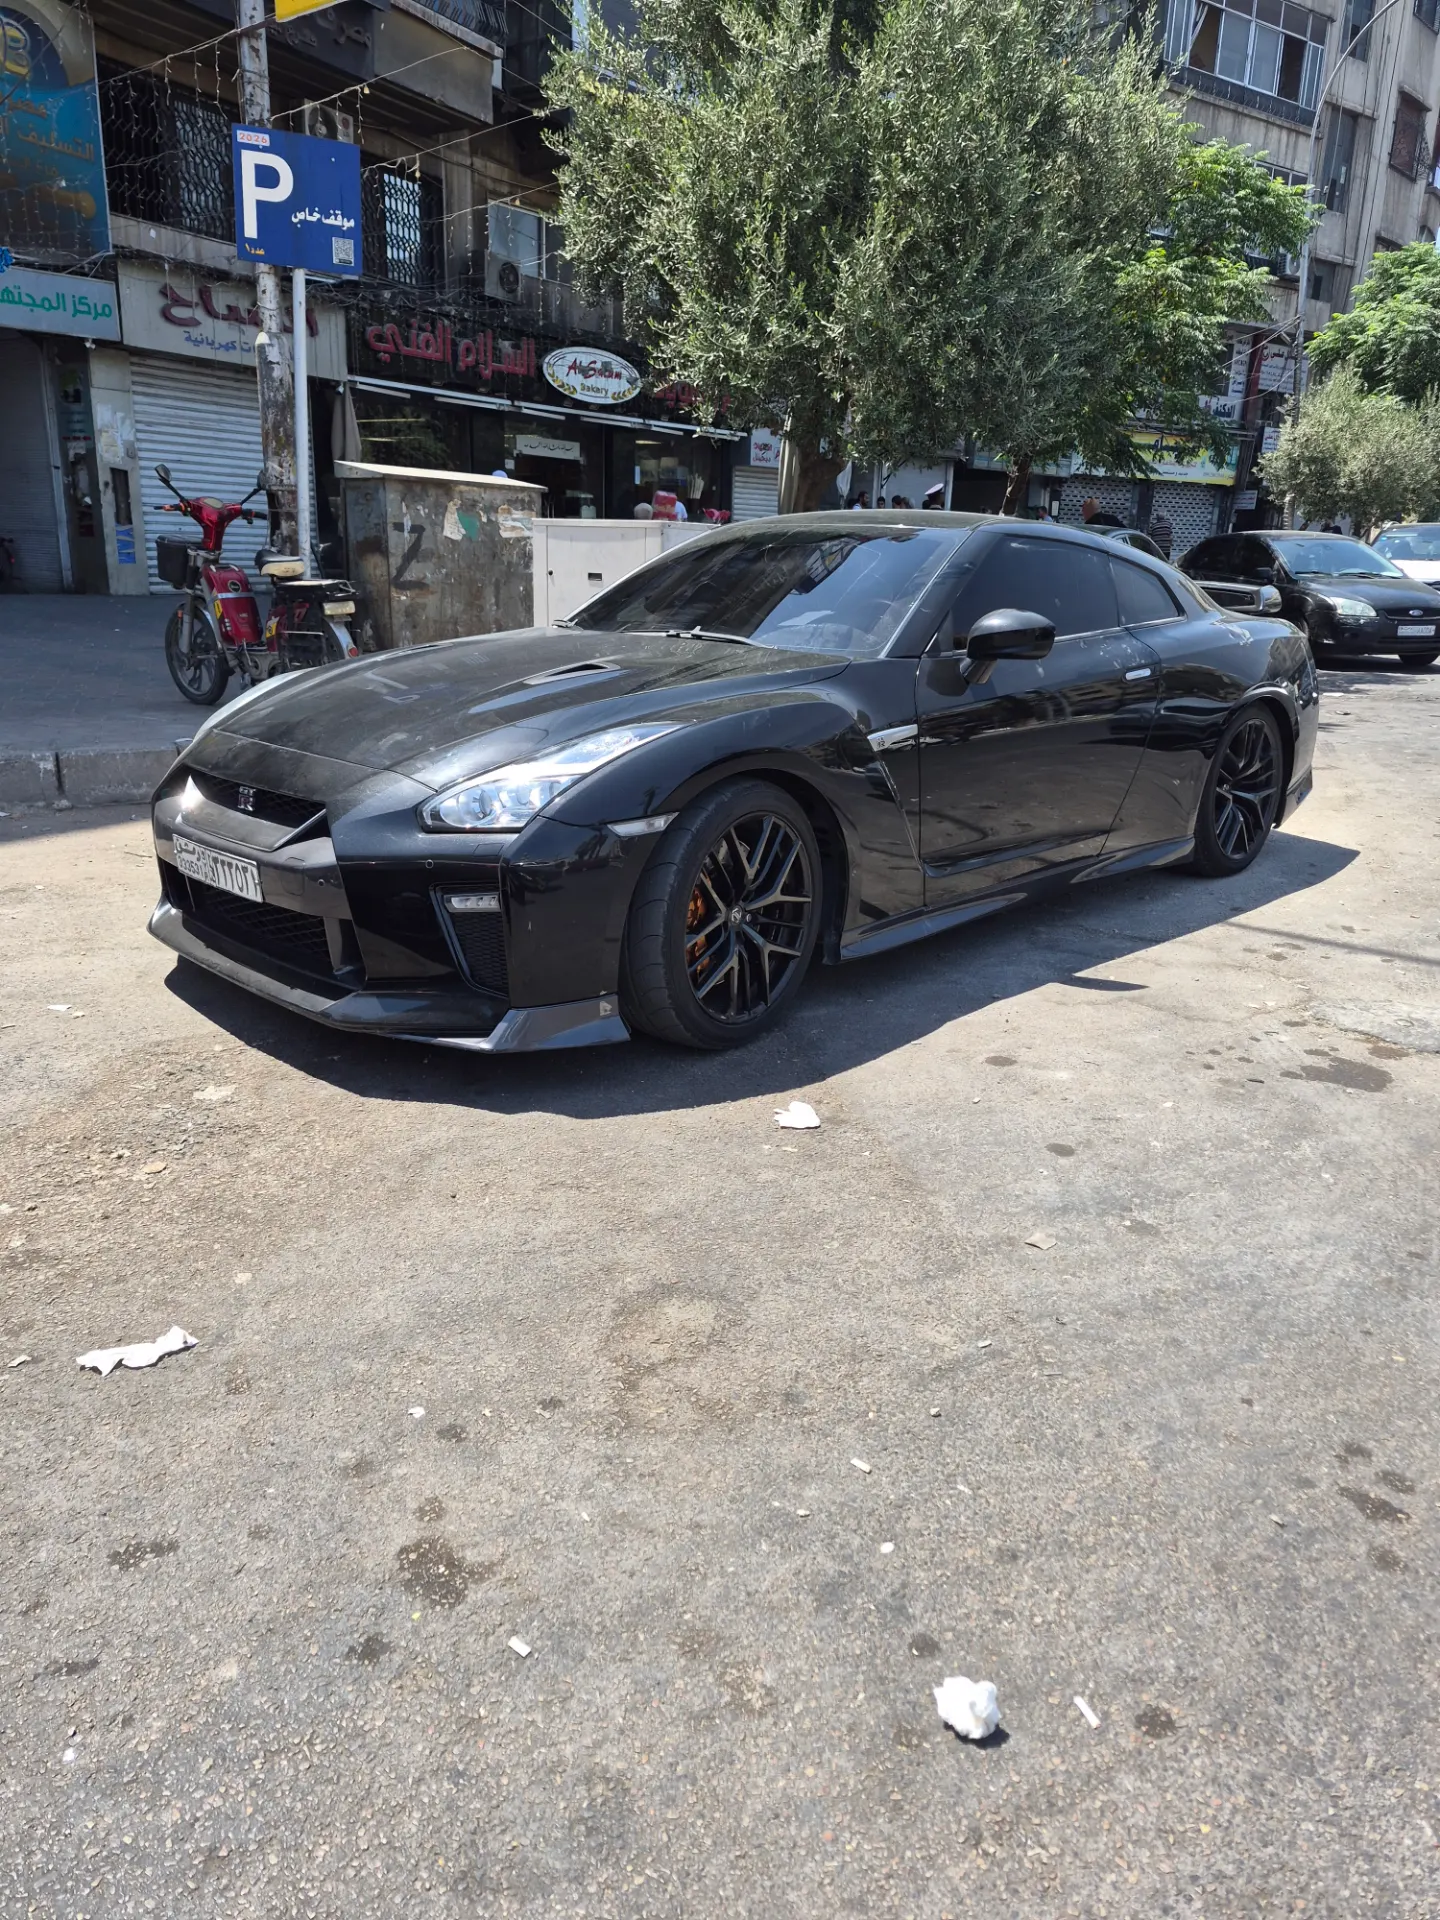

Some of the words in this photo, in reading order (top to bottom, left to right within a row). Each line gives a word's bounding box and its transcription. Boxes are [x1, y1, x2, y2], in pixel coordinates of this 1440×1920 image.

[239, 132, 268, 145] 2026
[241, 149, 294, 239] P
[291, 206, 321, 228] خاص
[322, 209, 355, 231] موقف
[0, 284, 67, 313] المجته
[71, 294, 113, 321] مركز
[367, 318, 452, 364] الفني
[458, 329, 536, 380] السلام
[580, 382, 609, 397] Bakery
